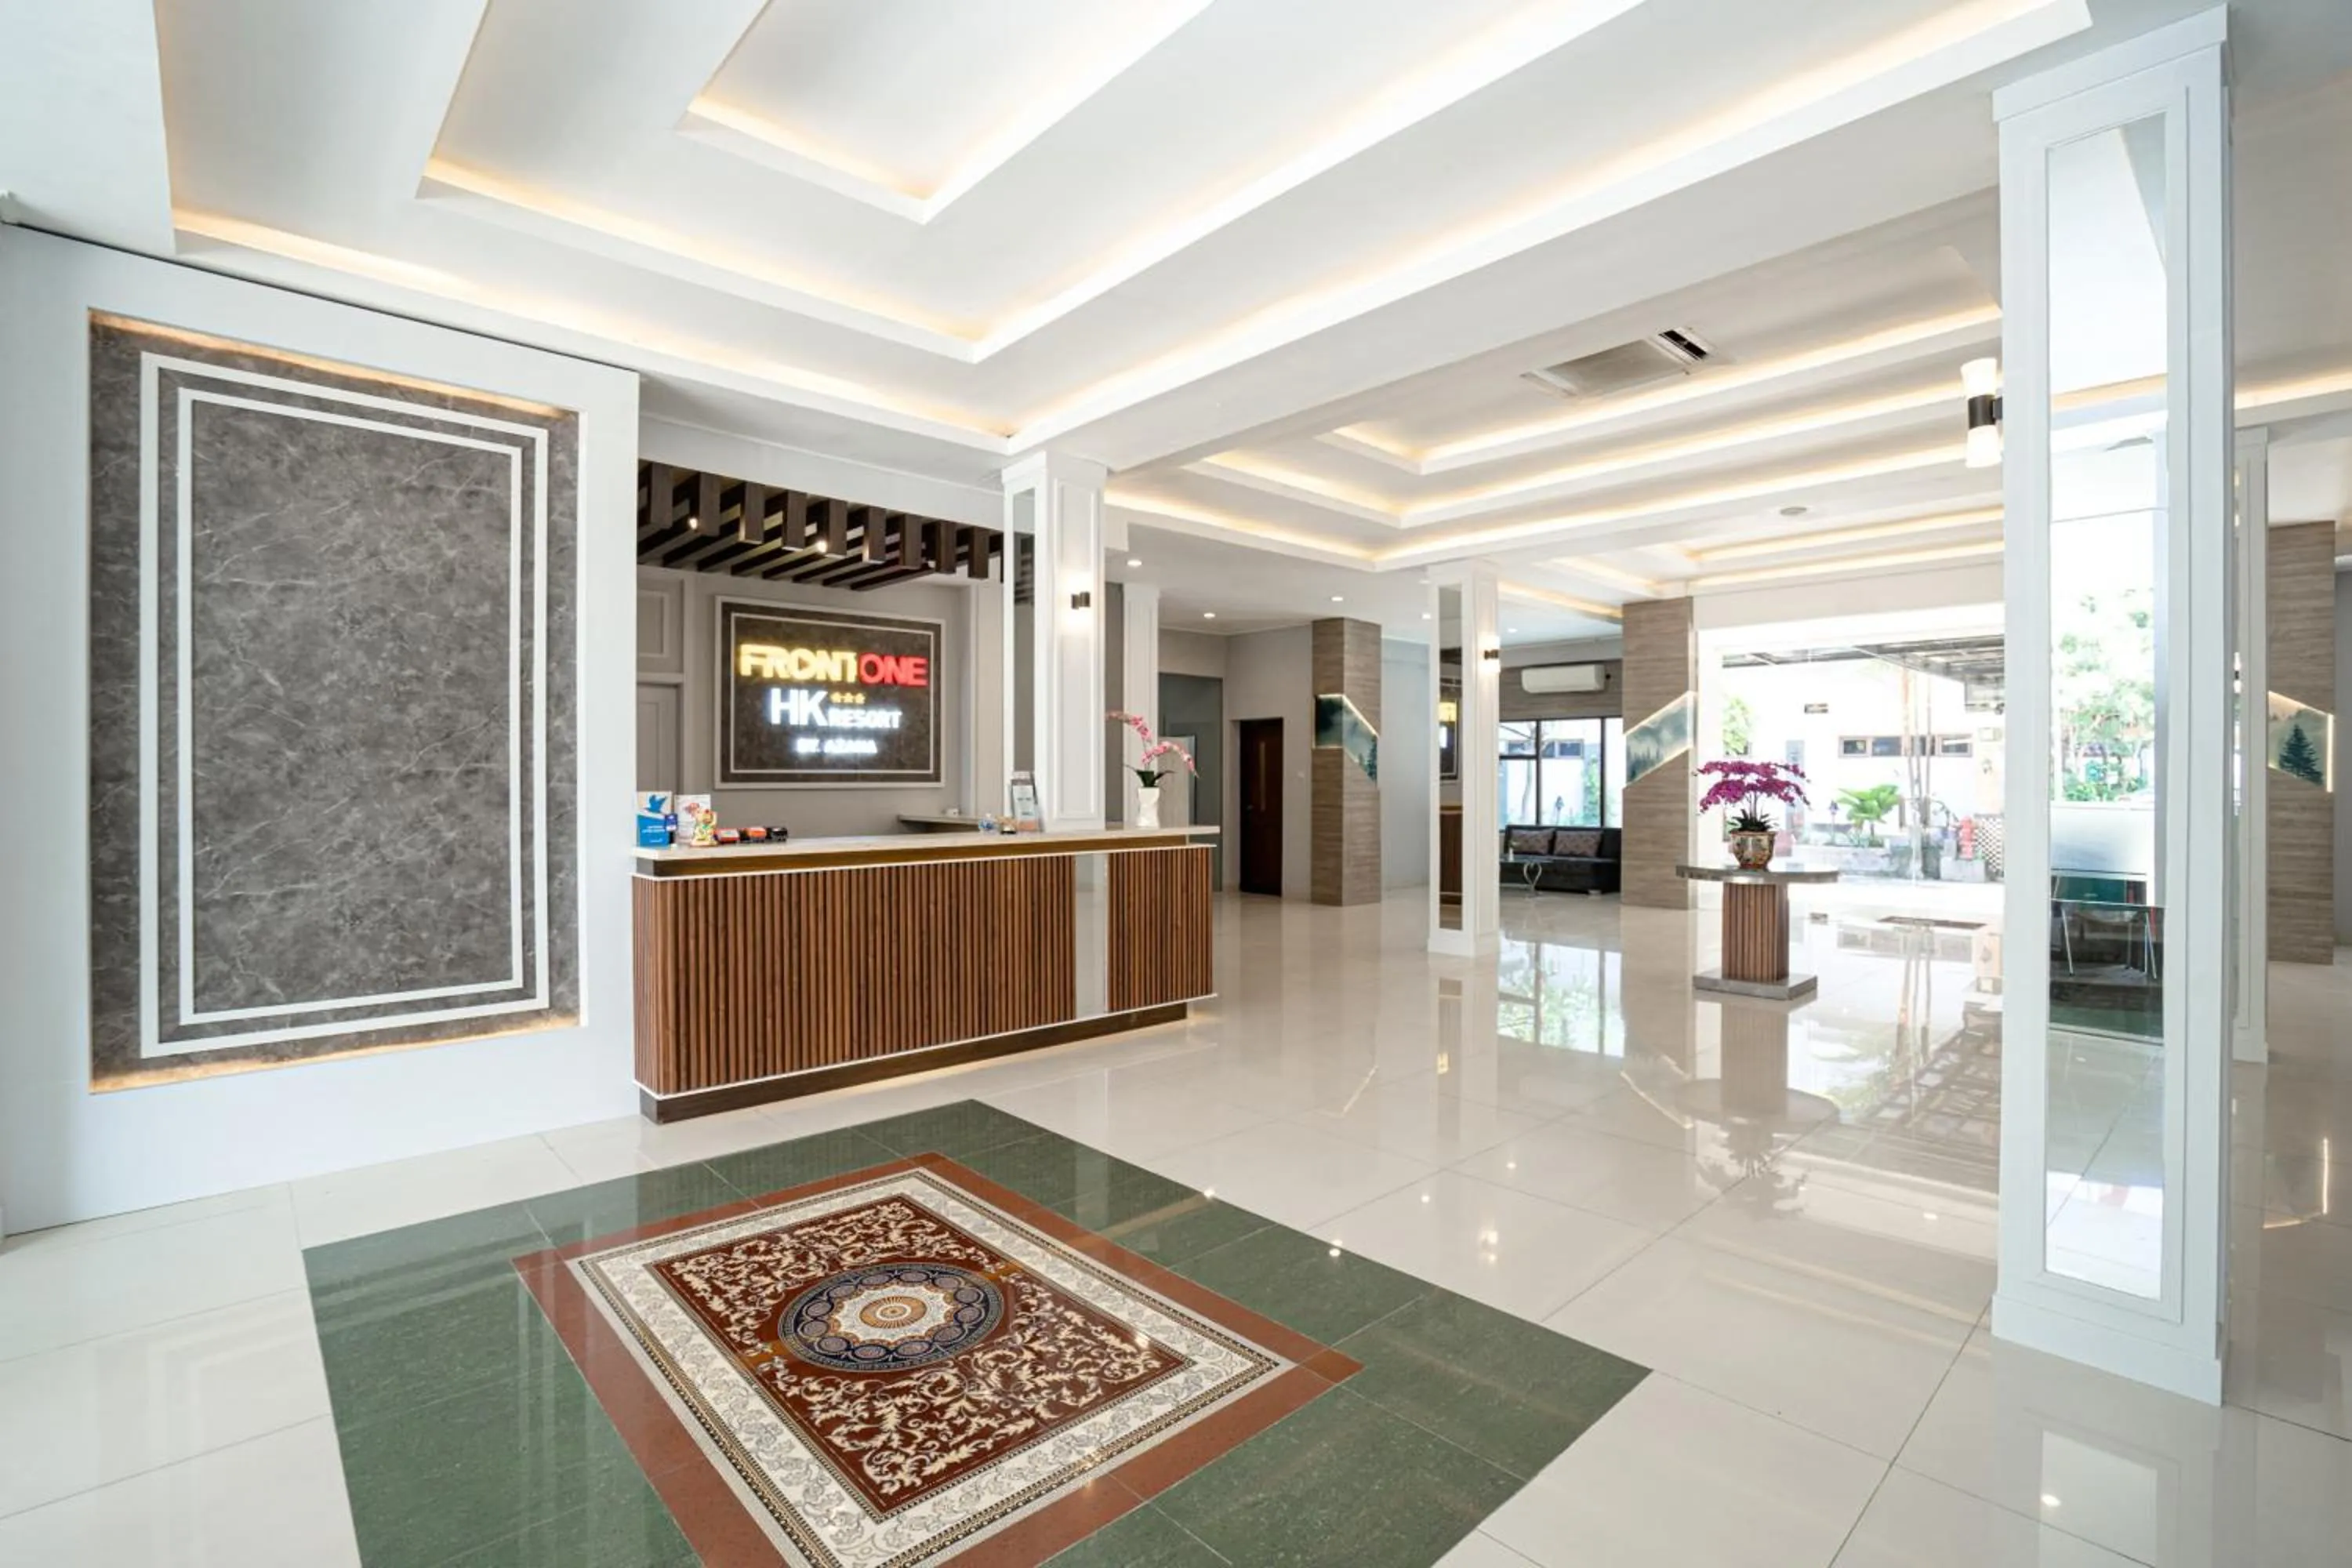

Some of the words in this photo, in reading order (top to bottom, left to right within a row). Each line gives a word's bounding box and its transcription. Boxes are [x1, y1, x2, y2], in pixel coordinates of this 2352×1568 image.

[740, 644, 857, 683] FRONT
[858, 653, 928, 686] ONE
[770, 688, 829, 726] HK
[827, 707, 902, 728] RESORT
